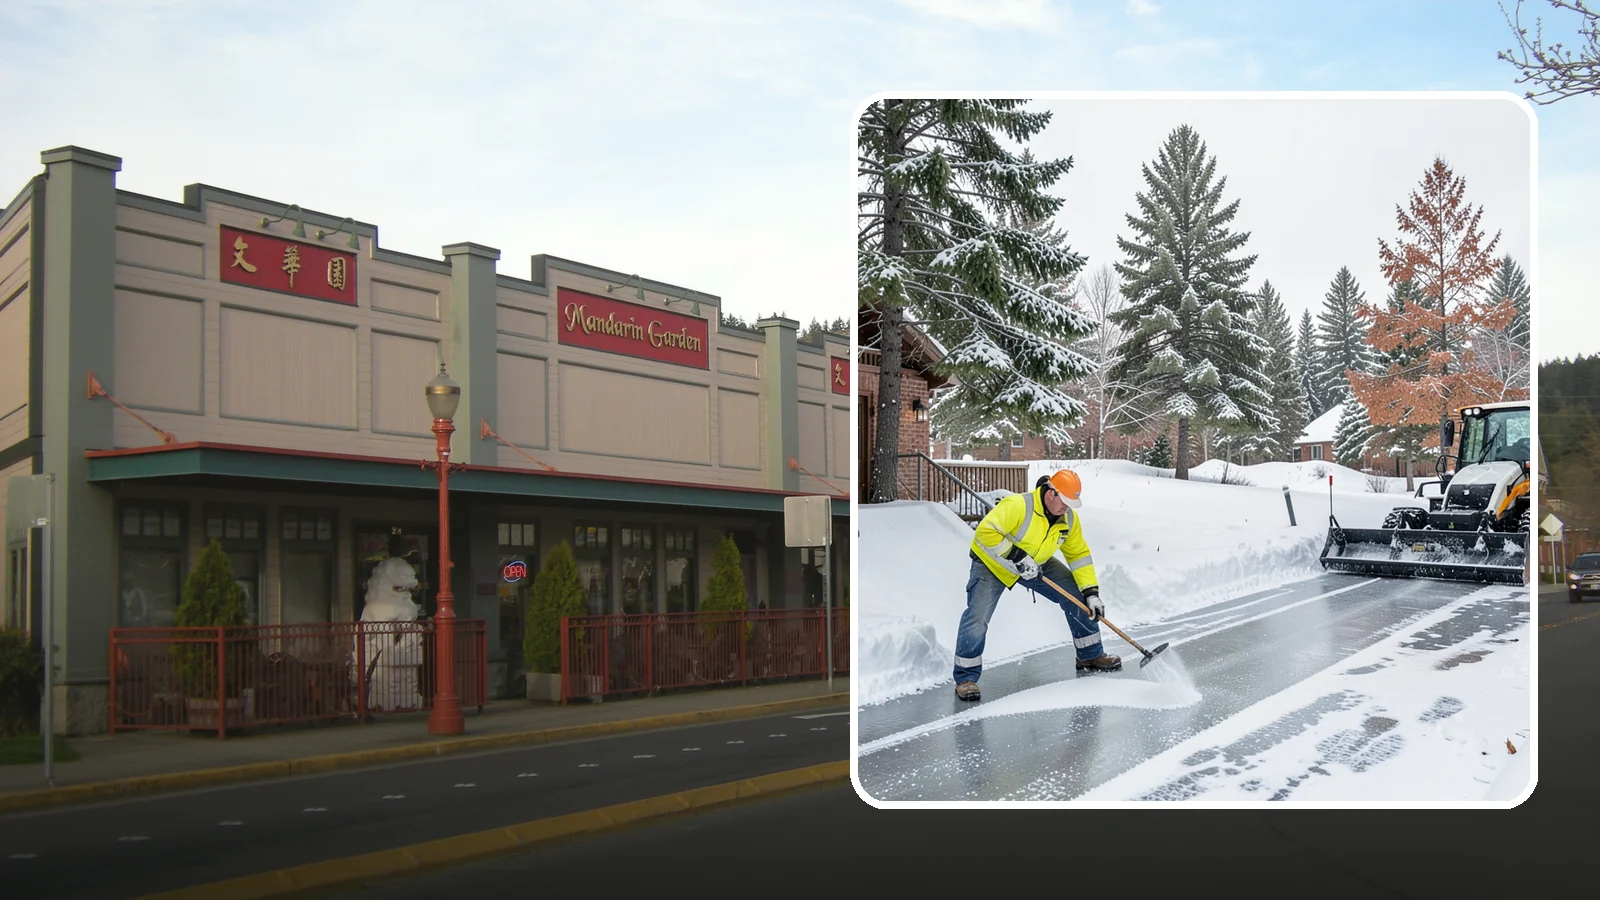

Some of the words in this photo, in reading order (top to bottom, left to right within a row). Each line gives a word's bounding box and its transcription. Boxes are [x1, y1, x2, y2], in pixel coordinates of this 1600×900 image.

[231, 235, 346, 291] 文華園
[564, 302, 644, 341] Mandarin
[648, 320, 702, 352] Garden
[503, 565, 527, 578] OPEN
